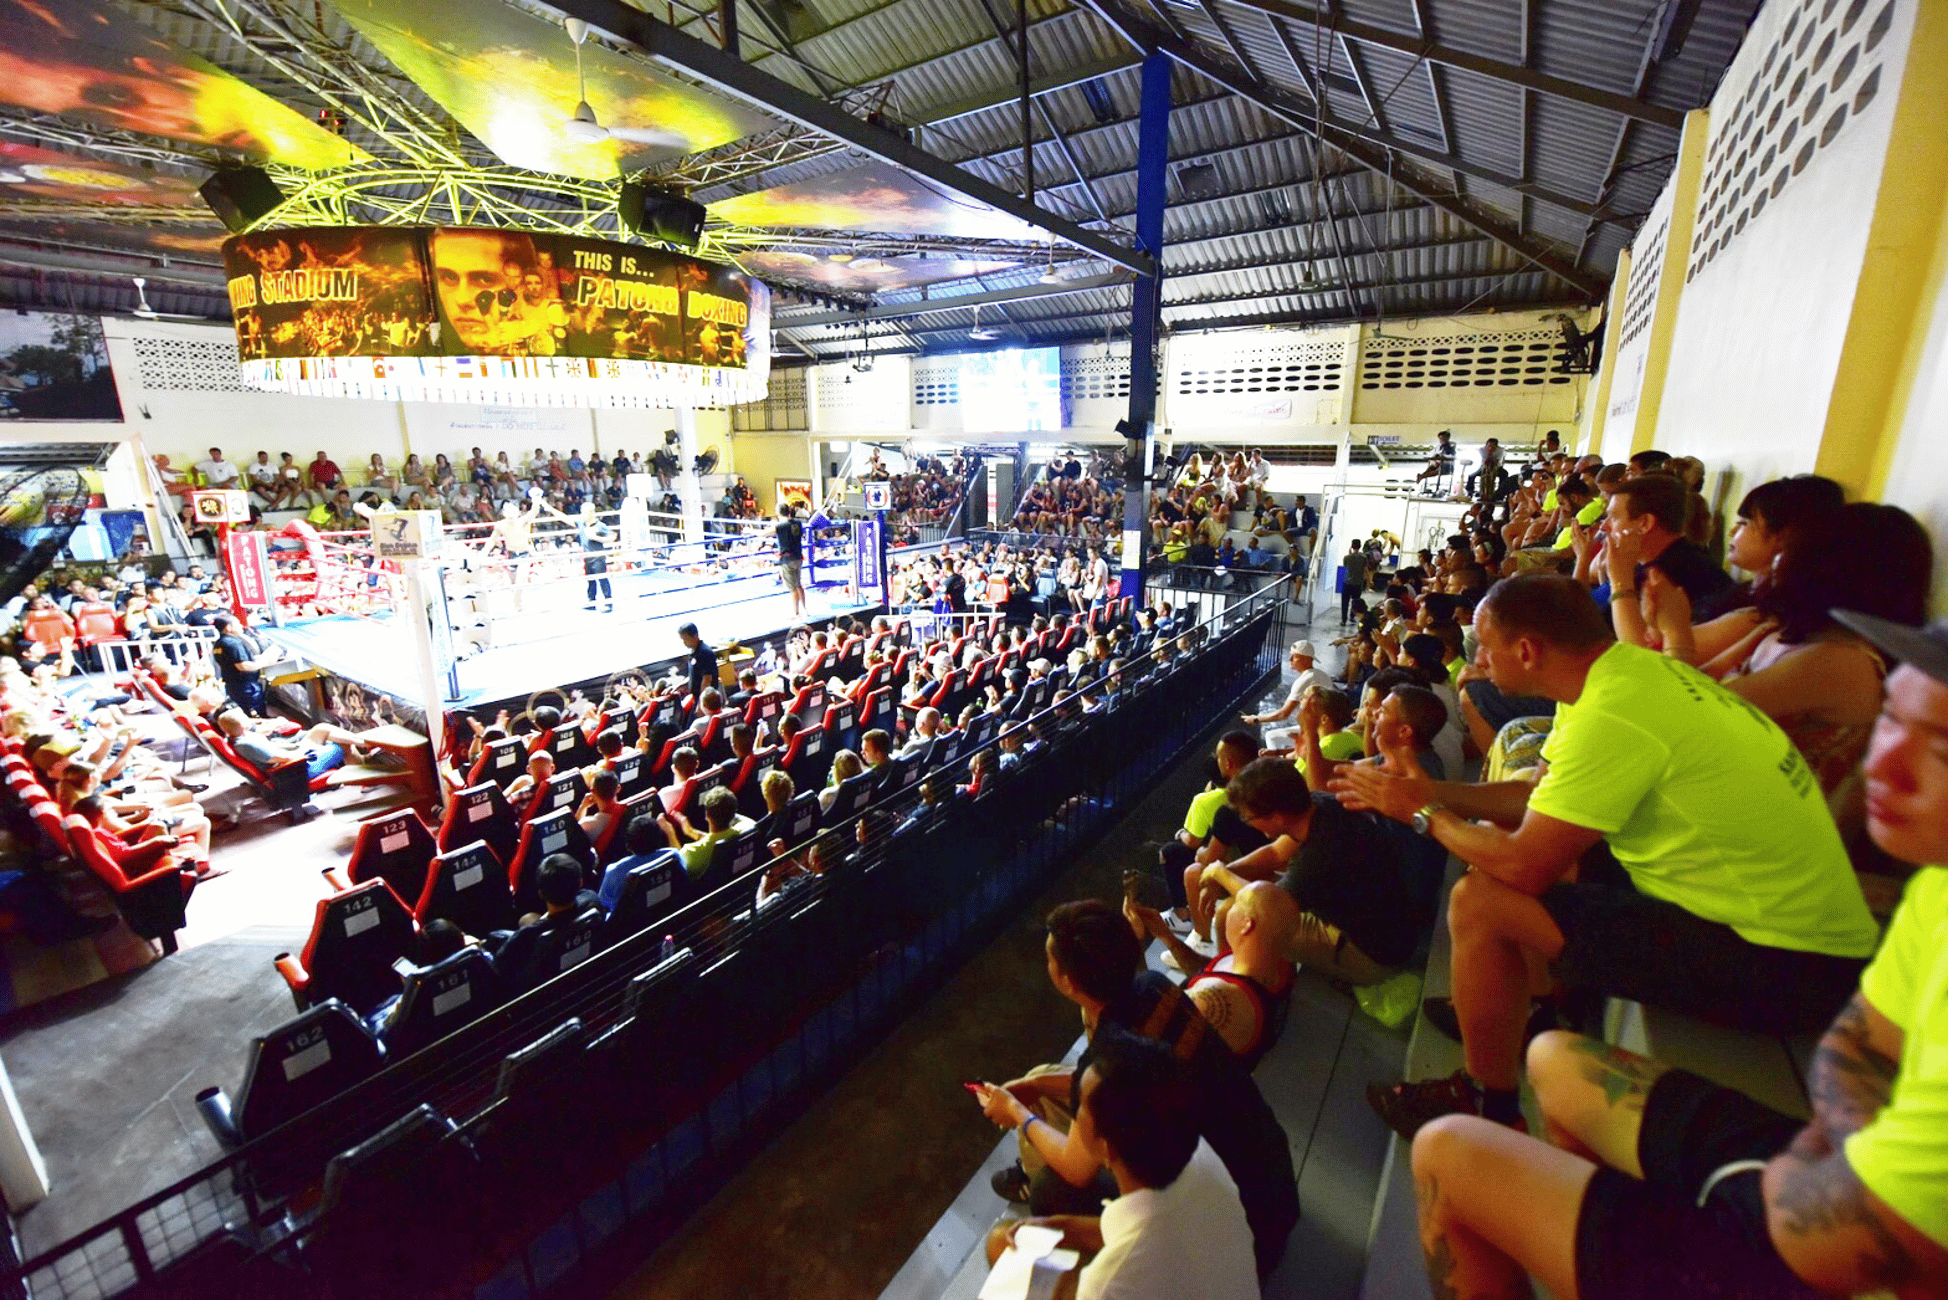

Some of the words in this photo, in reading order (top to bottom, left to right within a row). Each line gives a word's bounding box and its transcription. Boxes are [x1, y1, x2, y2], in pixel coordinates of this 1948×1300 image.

[573, 250, 613, 272] THIS
[621, 256, 654, 278] IS...
[260, 268, 358, 305] STADIUM
[577, 276, 680, 316] PATONG
[687, 290, 748, 328] BOXING
[240, 535, 259, 599] PATONG
[471, 791, 489, 804] 122
[556, 781, 574, 793] 121
[382, 819, 407, 834] 123
[543, 819, 565, 834] 140
[343, 896, 373, 914] 142
[286, 1025, 324, 1052] 162
